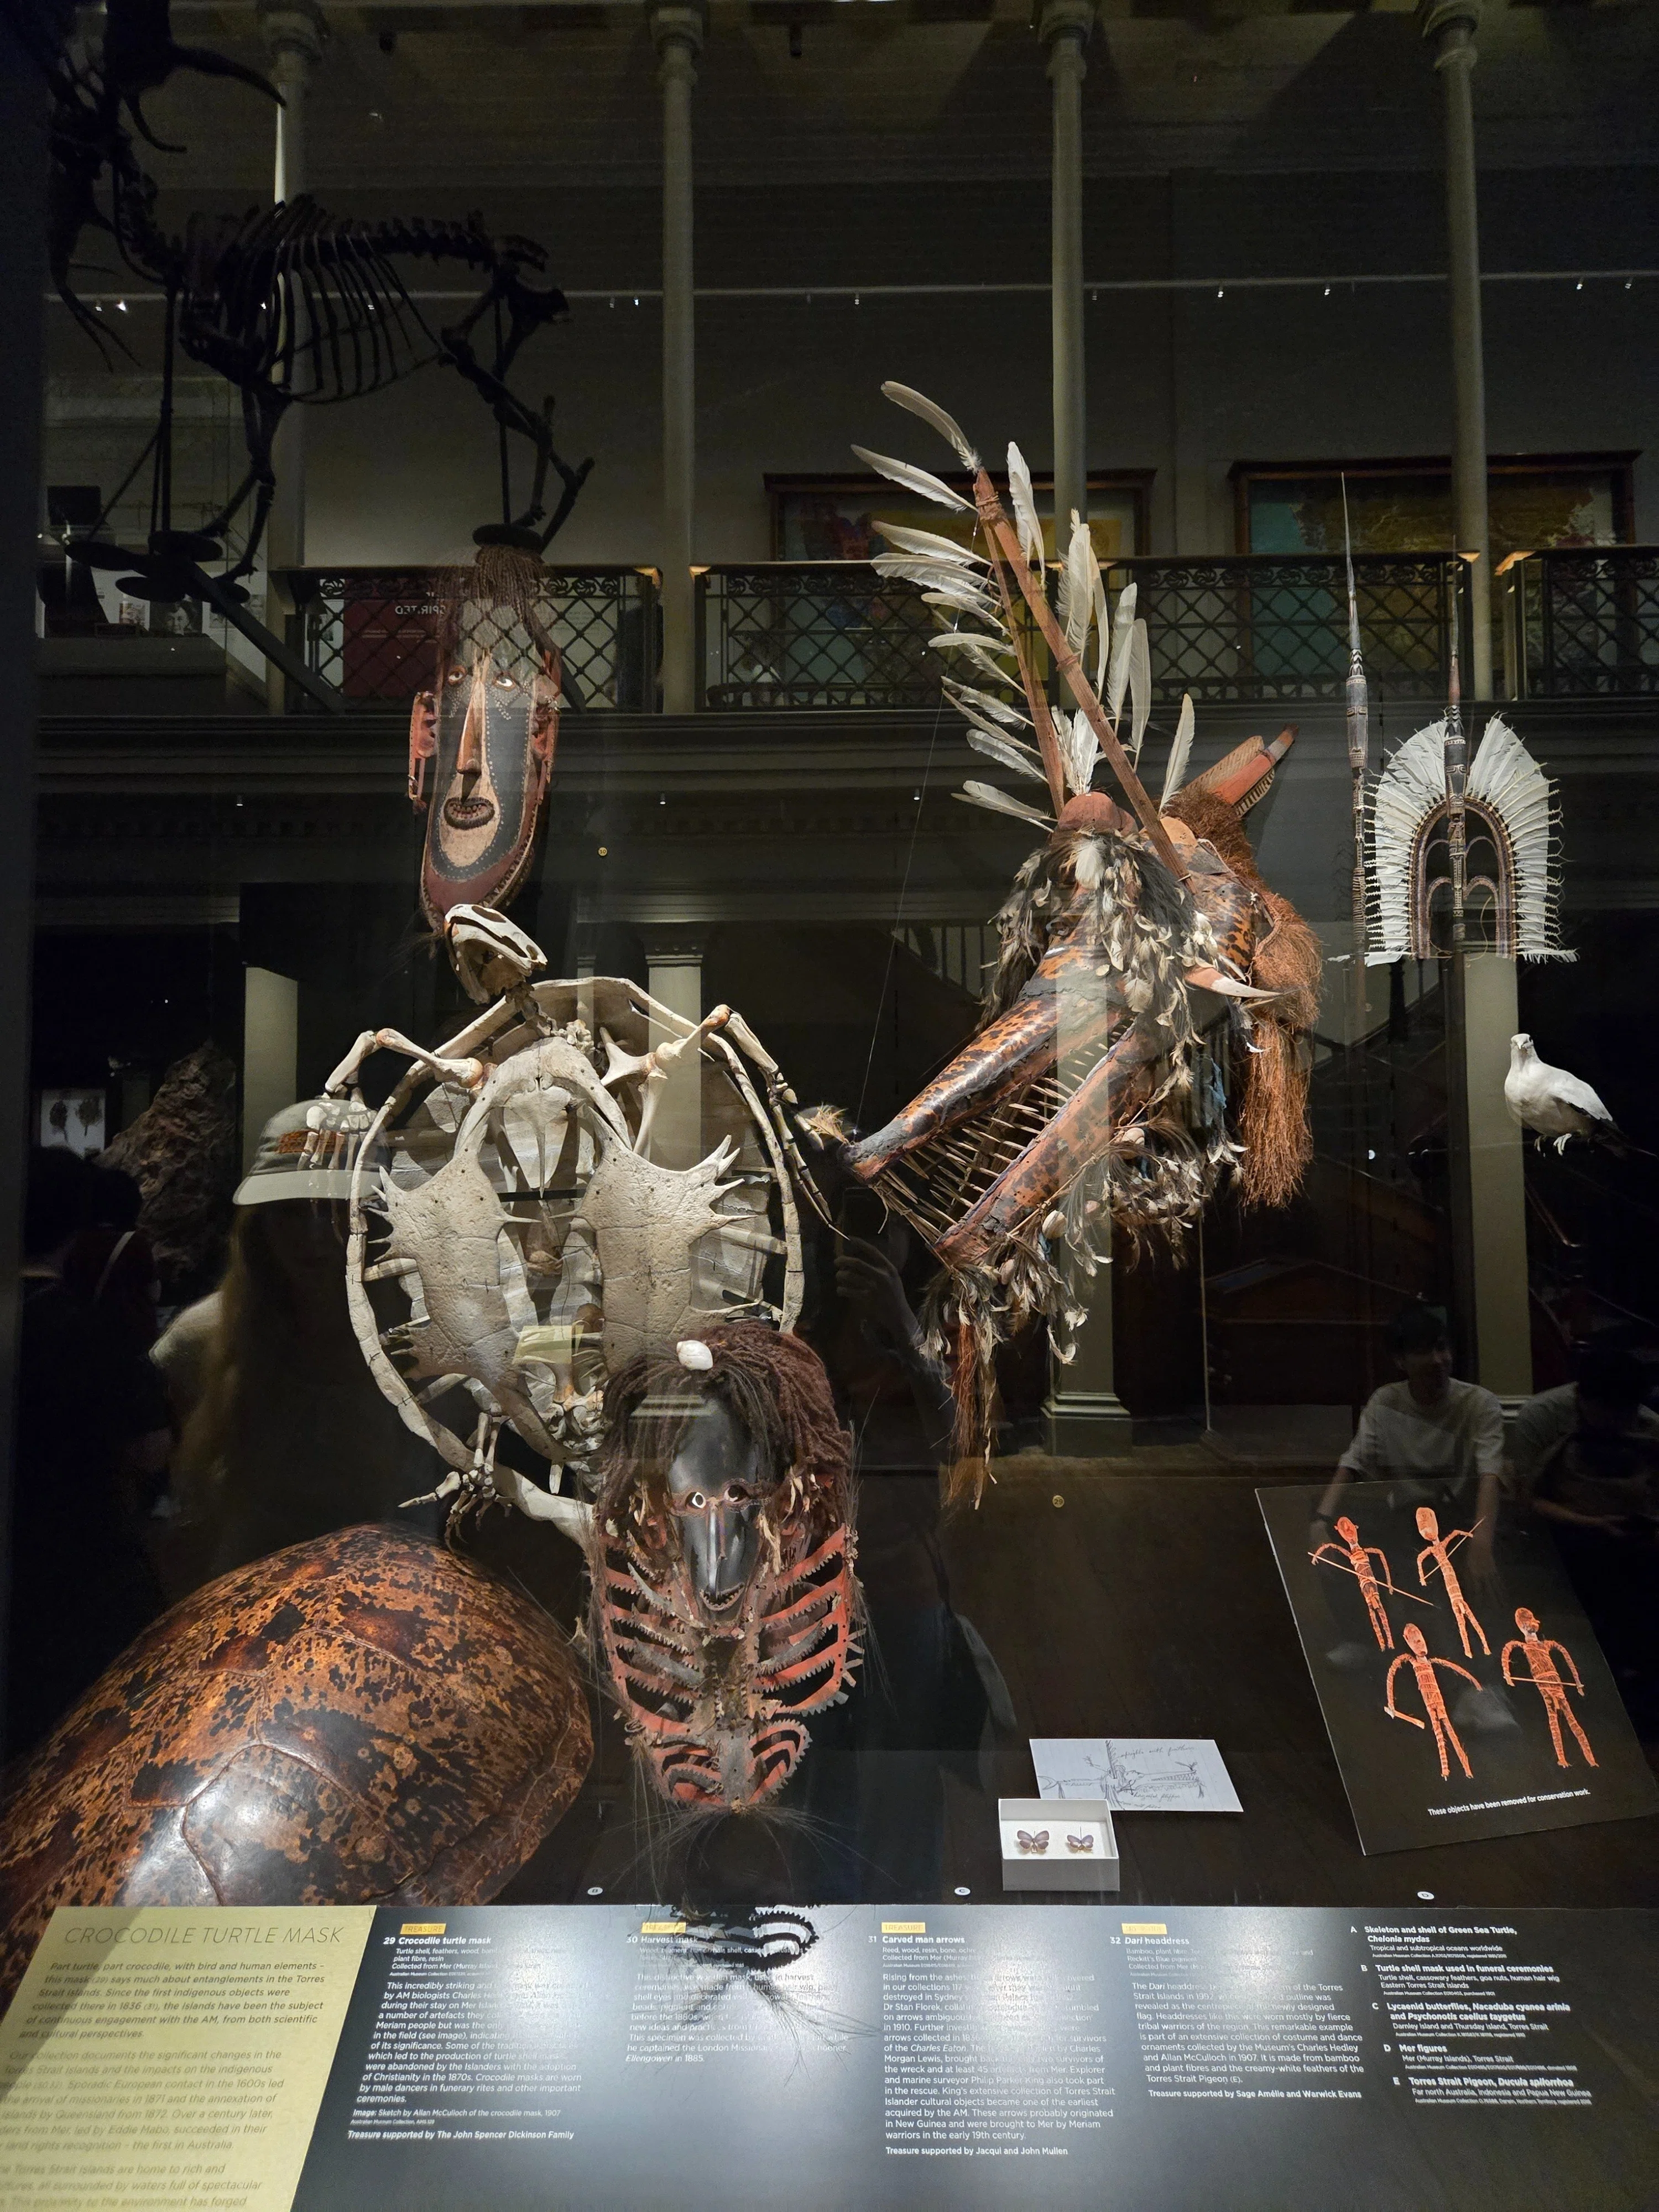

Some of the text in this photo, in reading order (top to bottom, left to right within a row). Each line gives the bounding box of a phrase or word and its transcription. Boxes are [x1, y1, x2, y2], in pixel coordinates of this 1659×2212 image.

[1447, 1804, 1470, 1813] objects
[1500, 1796, 1527, 1806] removed
[1536, 1791, 1574, 1801] conservation
[1489, 1926, 1517, 1934] Turtle,
[64, 1927, 343, 1944] CROCODILE TURTLE MASK
[442, 1936, 466, 1944] turtle
[626, 1935, 638, 1943] 30
[674, 1936, 698, 1944] mask
[1404, 1935, 1430, 1943] mydas
[102, 1963, 123, 1971] part
[197, 1961, 217, 1970] bird
[45, 1975, 61, 1983] this
[63, 1975, 91, 1984] mask
[109, 1976, 131, 1985] says
[133, 1975, 160, 1983] much
[161, 1975, 191, 1983] about
[192, 1975, 263, 1984] entanglements
[296, 1974, 325, 1983] Torres
[1386, 2002, 1424, 2011] Lycaenid
[1425, 2002, 1472, 2011] butterflies,
[1407, 2012, 1457, 2021] Psychonotis
[1489, 2012, 1526, 2021] taygetus
[1383, 2043, 1391, 2052] D
[1417, 2044, 1447, 2053] figures
[625, 2054, 672, 2063] Ellengowen
[362, 2072, 373, 2081] of
[373, 2073, 420, 2081] Christianity
[422, 2073, 430, 2081] in
[432, 2073, 446, 2081] the
[1198, 2075, 1228, 2084] Pigeon
[1392, 2077, 1400, 2085] E
[1408, 2077, 1436, 2085] Torres
[1437, 2077, 1462, 2085] Strait
[1462, 2077, 1497, 2088] Pigeon,
[1498, 2077, 1528, 2086] Ducula
[1224, 2089, 1234, 2098] by
[1235, 2090, 1255, 2098] Sage
[1337, 2090, 1361, 2098] Evans
[348, 2130, 574, 2140] Treasure supported by The John Spencer Dickinson Family
[885, 2131, 920, 2139] warriors
[932, 2130, 947, 2139] the
[948, 2131, 969, 2140] early
[972, 2131, 990, 2139] 19th
[992, 2131, 1026, 2140] century.
[921, 2146, 962, 2155] supported
[963, 2146, 973, 2156] by
[975, 2146, 1001, 2156] Jacqui
[1003, 2146, 1019, 2154] and
